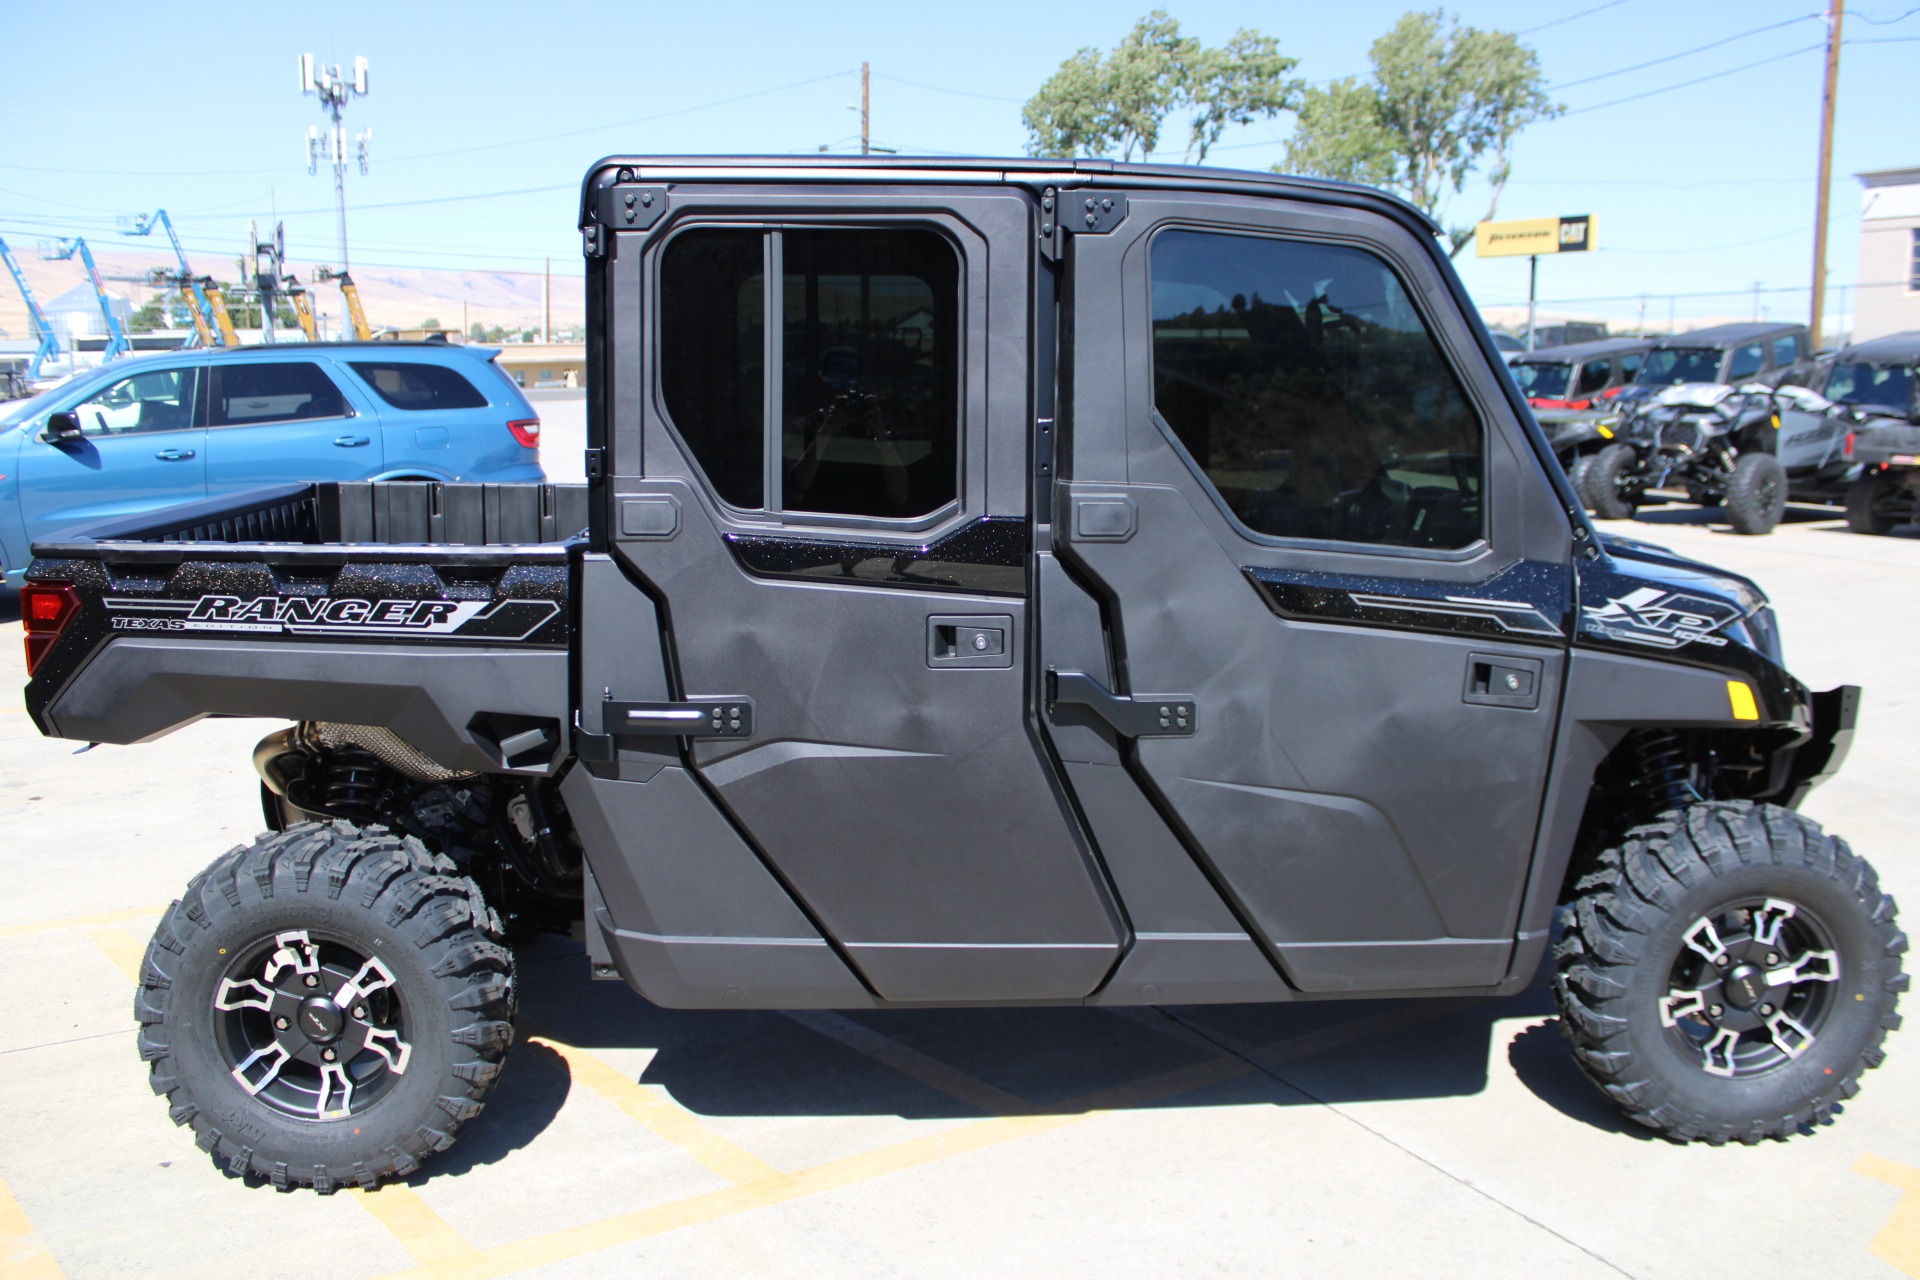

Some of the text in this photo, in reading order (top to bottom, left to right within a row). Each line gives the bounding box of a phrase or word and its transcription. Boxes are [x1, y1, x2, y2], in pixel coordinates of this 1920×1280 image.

[1560, 222, 1587, 244] CAT
[188, 594, 459, 625] RANGER
[111, 617, 274, 631] TEXAS EDITION
[1673, 630, 1729, 647] 1000
